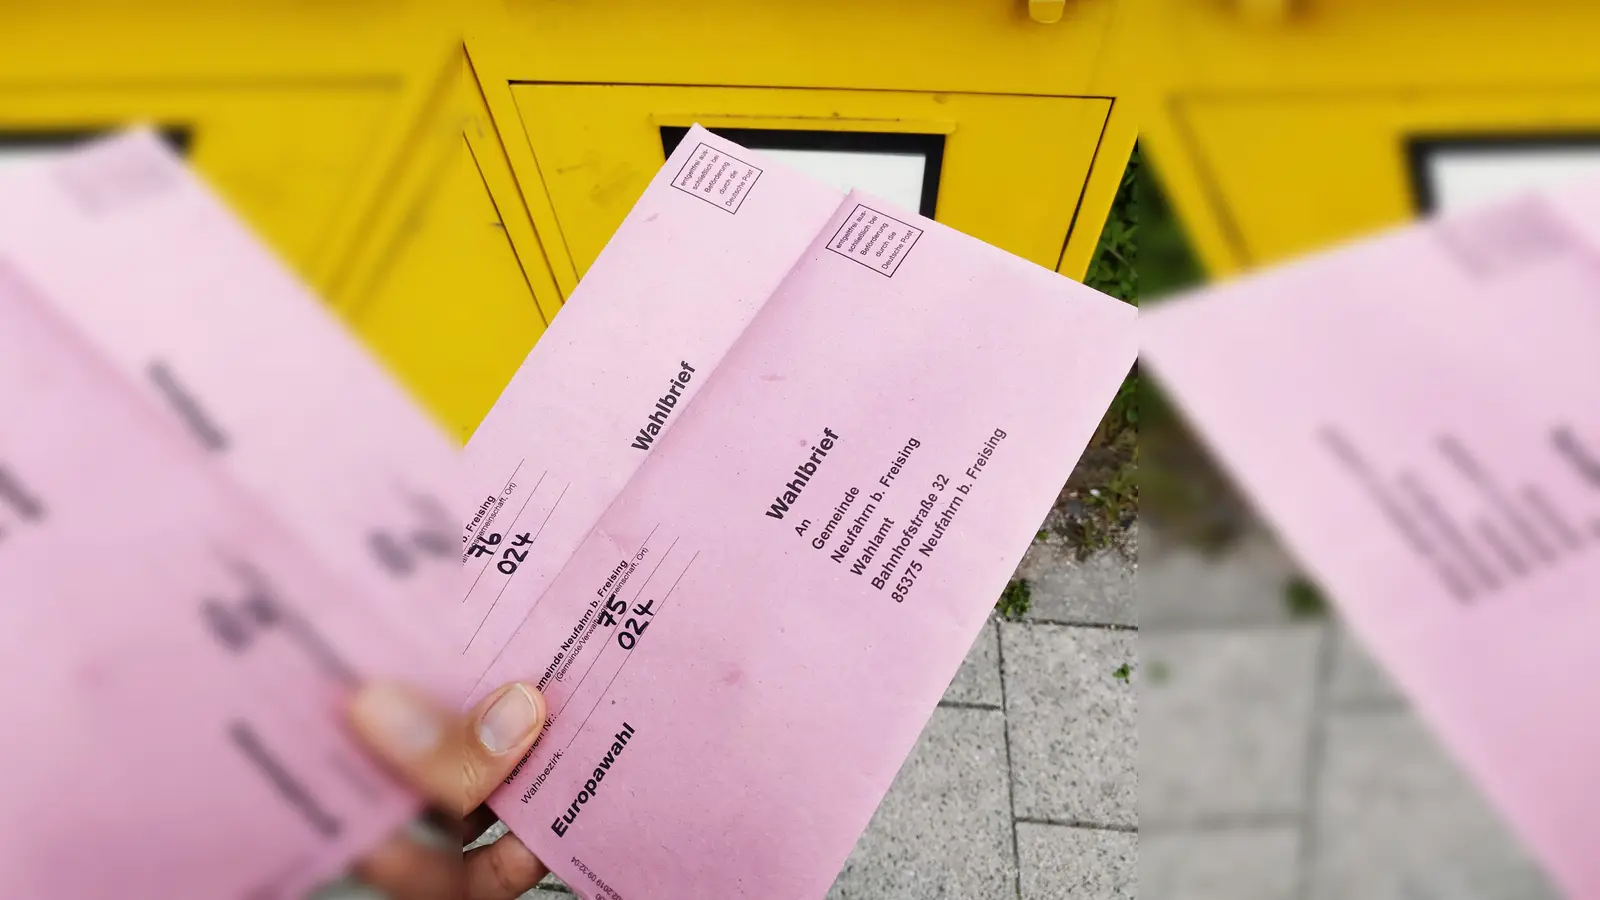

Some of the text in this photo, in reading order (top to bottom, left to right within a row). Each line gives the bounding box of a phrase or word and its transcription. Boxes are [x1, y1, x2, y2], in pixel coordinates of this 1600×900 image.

[681, 160, 700, 187] entgeltfrei
[693, 155, 720, 190] schließlich bei
[704, 161, 731, 193] Beförderung
[719, 170, 739, 195] durch die
[725, 169, 754, 207] Deutsche Post
[836, 222, 858, 249] entgeltfrei
[848, 216, 878, 253] schließlich bei
[860, 222, 890, 256] Beförderung
[875, 231, 897, 257] durch die
[881, 230, 914, 270] Deutsche Post
[631, 360, 696, 451] Wahlbrief
[504, 482, 517, 496] Ort)
[765, 427, 839, 521] Wahlbrief
[465, 495, 497, 533] Freising
[811, 485, 860, 550] Gemeinde
[830, 437, 921, 564] Neufahrn b. Freising
[891, 427, 1007, 603] 85375 Neufahrn b. Freising
[467, 533, 502, 557] 76
[794, 518, 812, 537] An
[850, 516, 895, 577] Wahlamt
[870, 473, 950, 591] Bahnhofstraße 32
[497, 532, 534, 575] 024
[636, 547, 649, 561] Ort)
[535, 559, 629, 691] emeinde Neufahrn b. Freising
[596, 593, 628, 627] 75
[617, 599, 654, 650] 024
[520, 748, 565, 805] Wahlbezirk:
[551, 721, 636, 838] Europawahl
